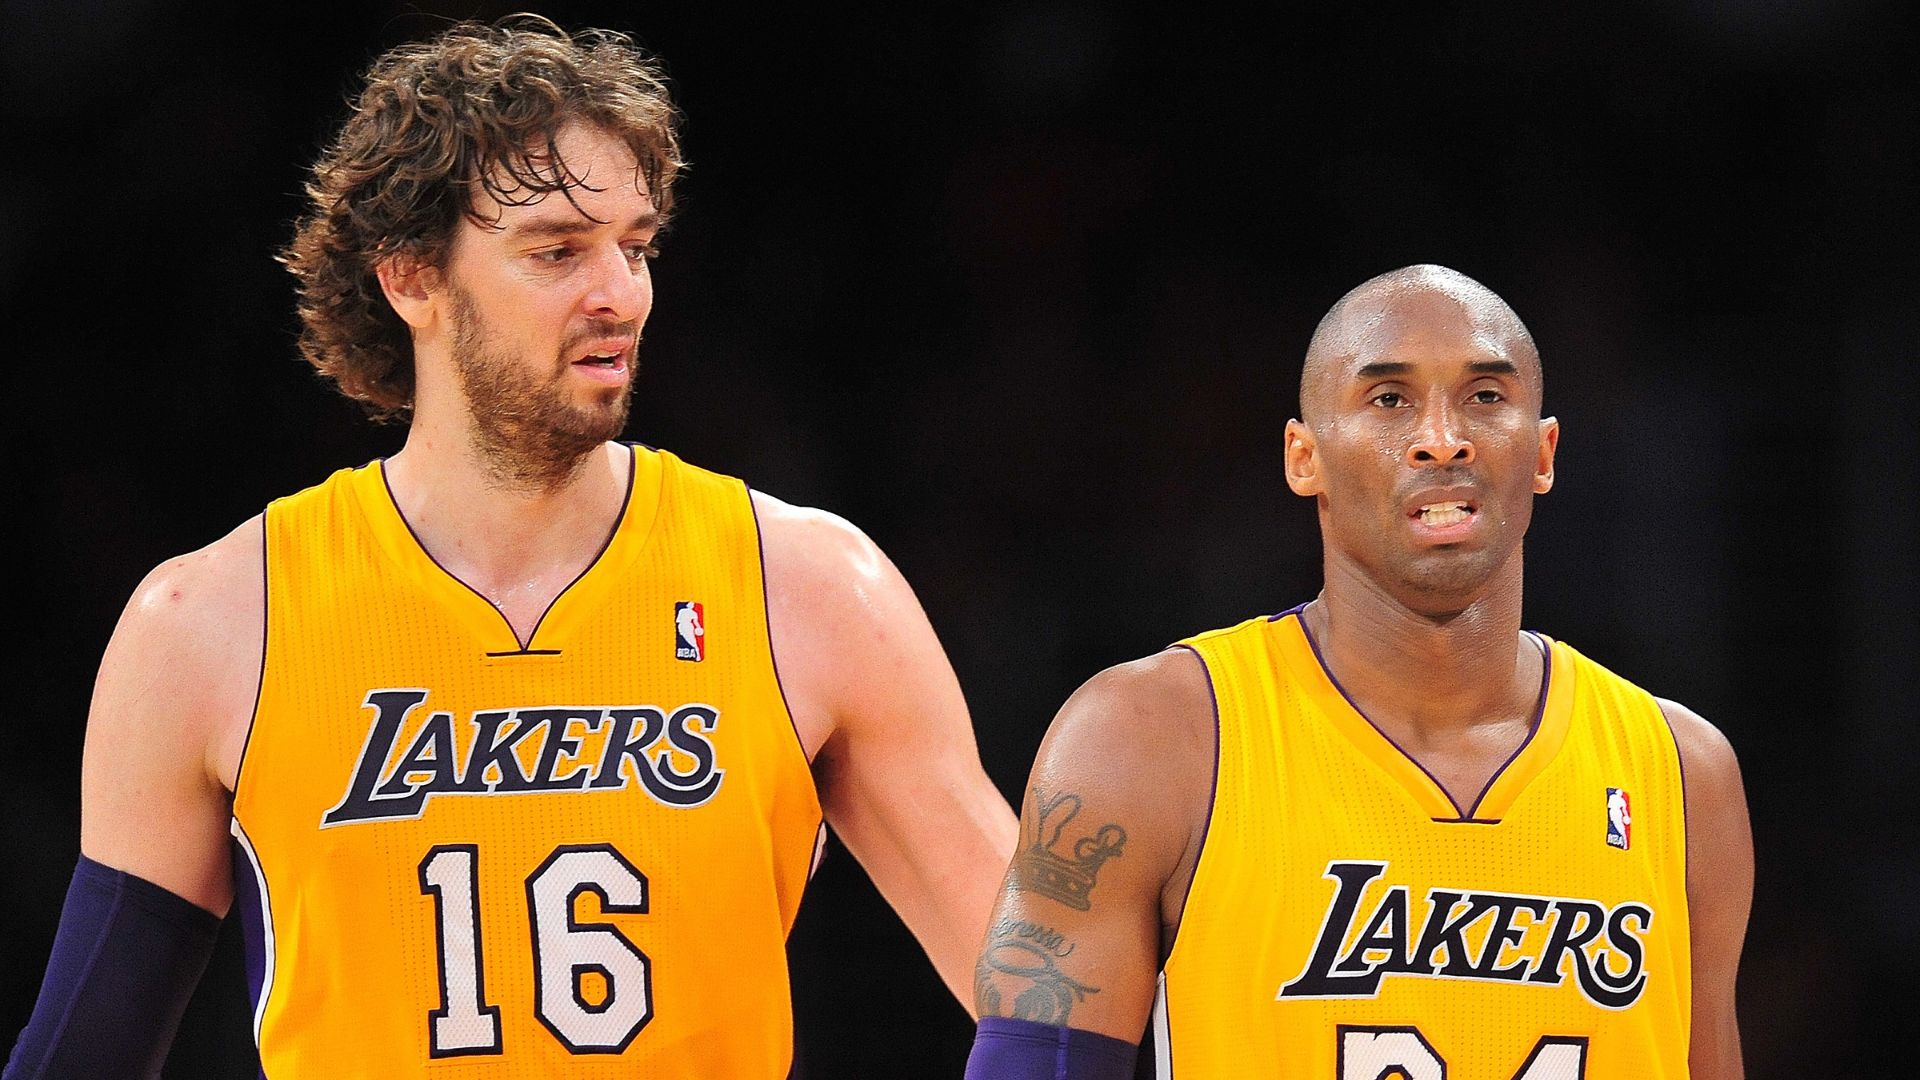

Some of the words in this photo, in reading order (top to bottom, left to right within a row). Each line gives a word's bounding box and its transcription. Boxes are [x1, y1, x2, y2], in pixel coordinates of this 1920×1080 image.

[319, 687, 726, 829] LAKERS
[418, 843, 654, 1059] 16
[1275, 859, 1654, 1011] LAKERS
